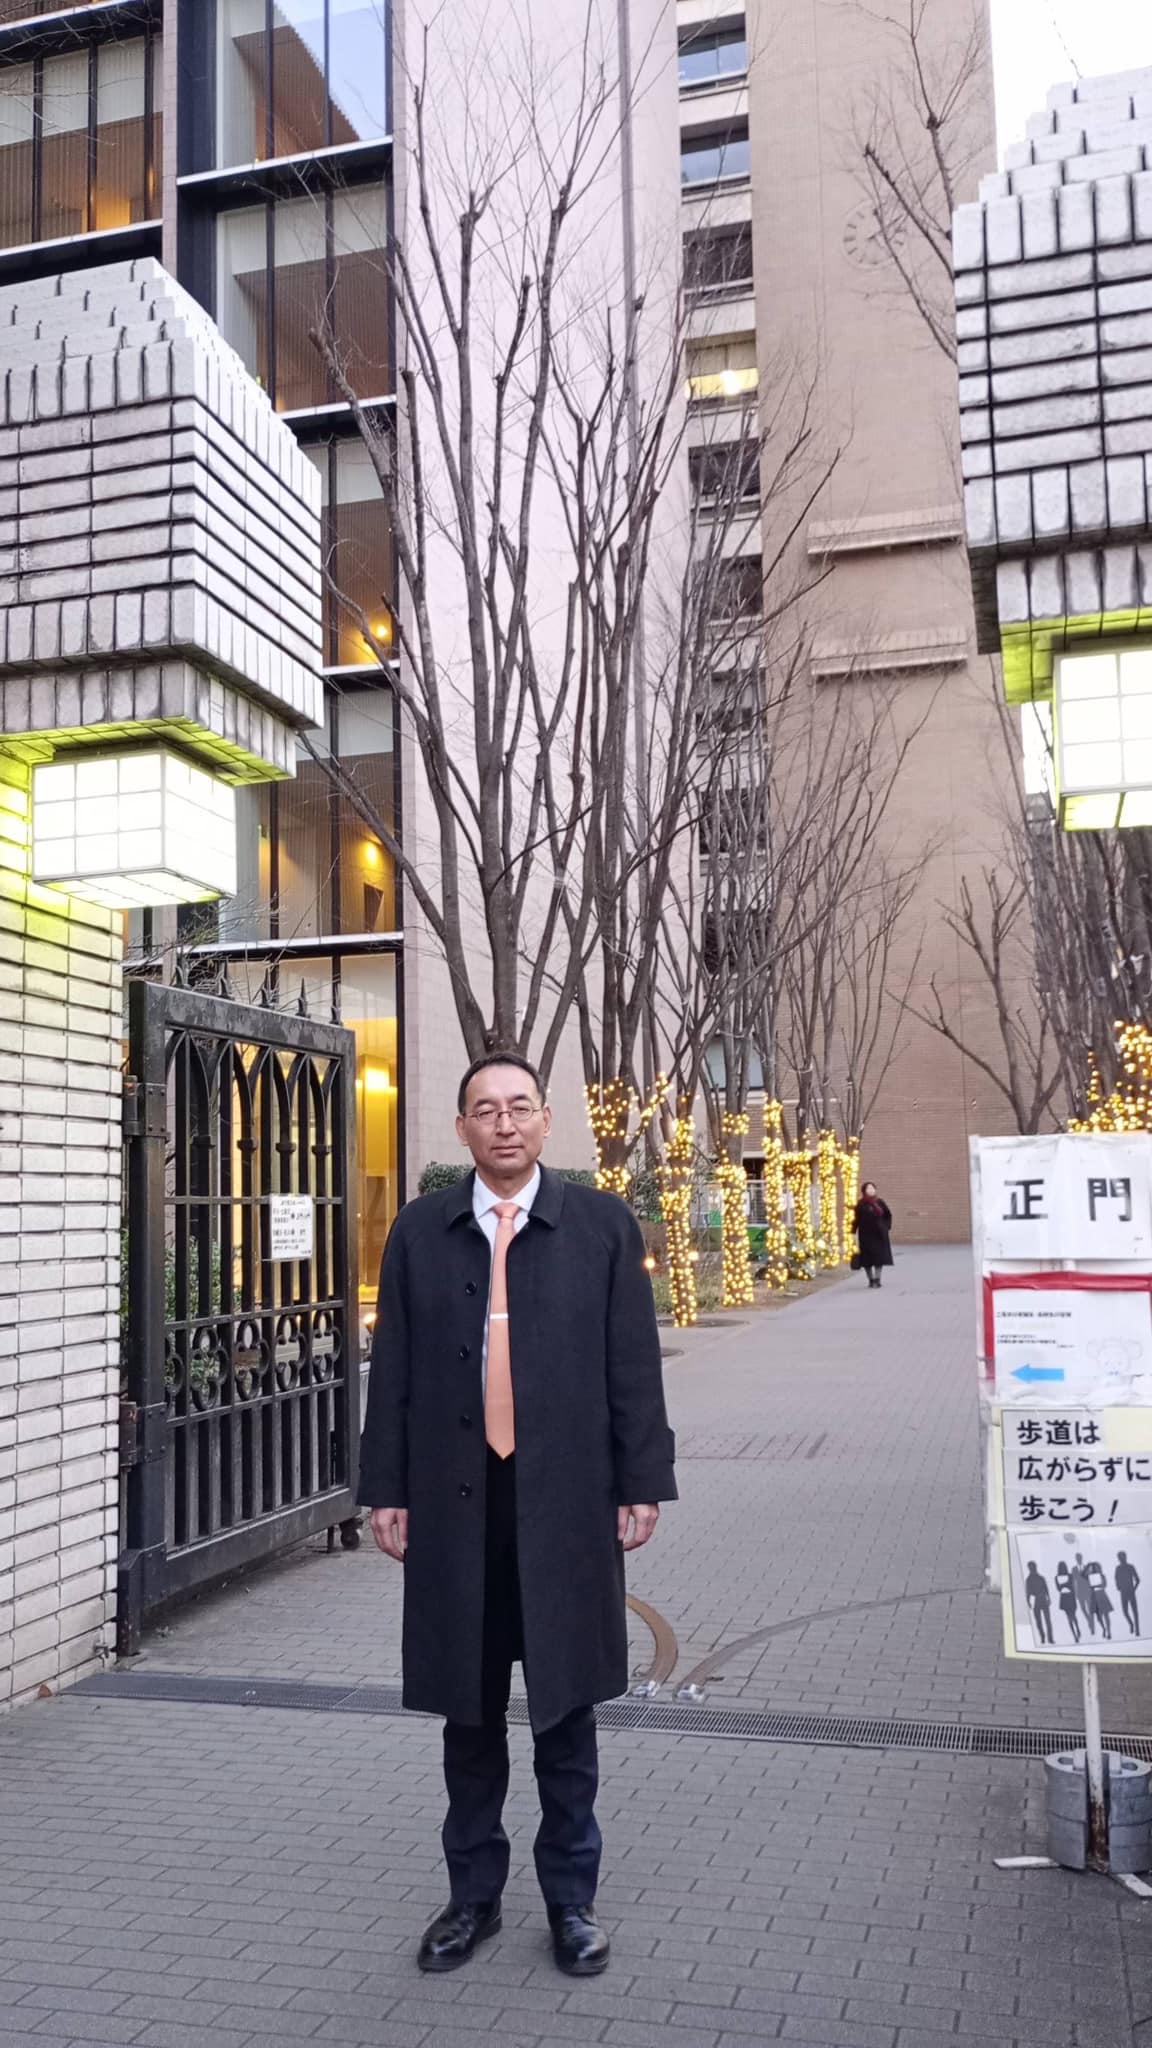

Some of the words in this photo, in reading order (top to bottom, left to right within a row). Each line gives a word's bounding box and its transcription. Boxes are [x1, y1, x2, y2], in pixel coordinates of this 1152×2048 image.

[1003, 1178, 1132, 1221] 正門
[1017, 1419, 1101, 1445] 歩道は
[1018, 1455, 1151, 1482] 広がらずに
